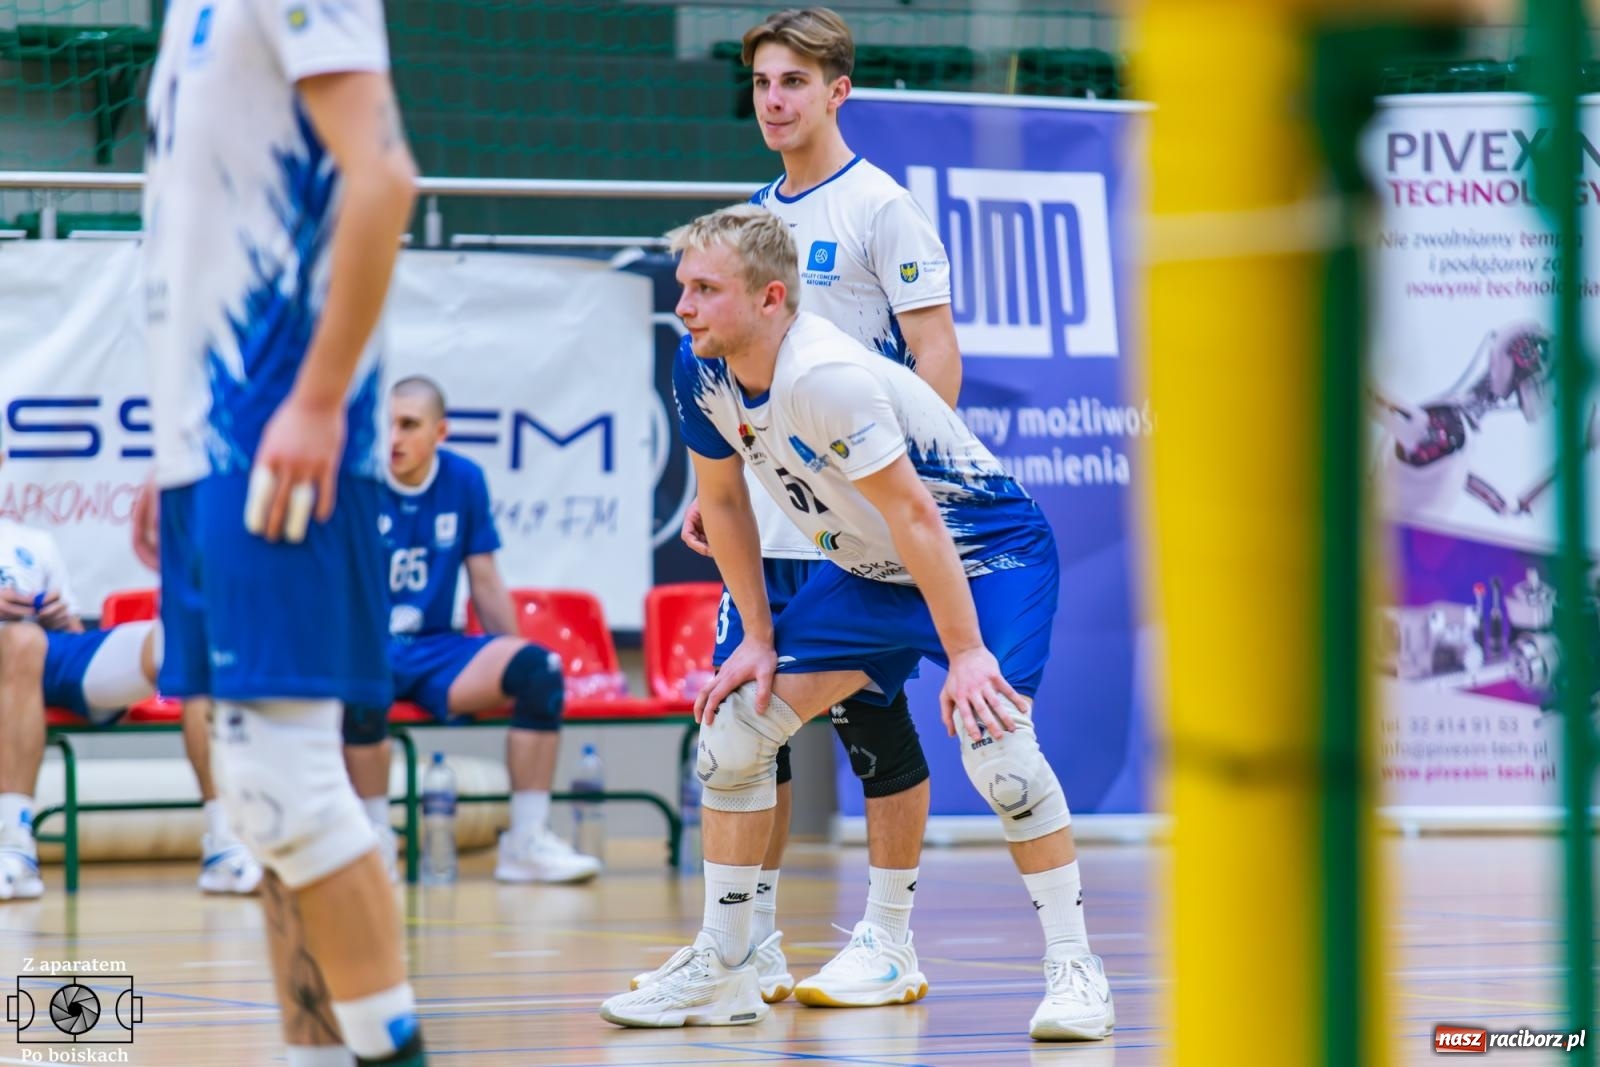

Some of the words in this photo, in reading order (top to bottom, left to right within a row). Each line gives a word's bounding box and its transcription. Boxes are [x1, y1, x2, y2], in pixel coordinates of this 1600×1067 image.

[1386, 128, 1600, 173] PIVEXN
[1387, 179, 1600, 207] TECHNOLGY
[933, 166, 1088, 358] bmp
[1017, 396, 1158, 437] możliwoś
[1000, 446, 1131, 485] umienia
[389, 547, 428, 592] 65
